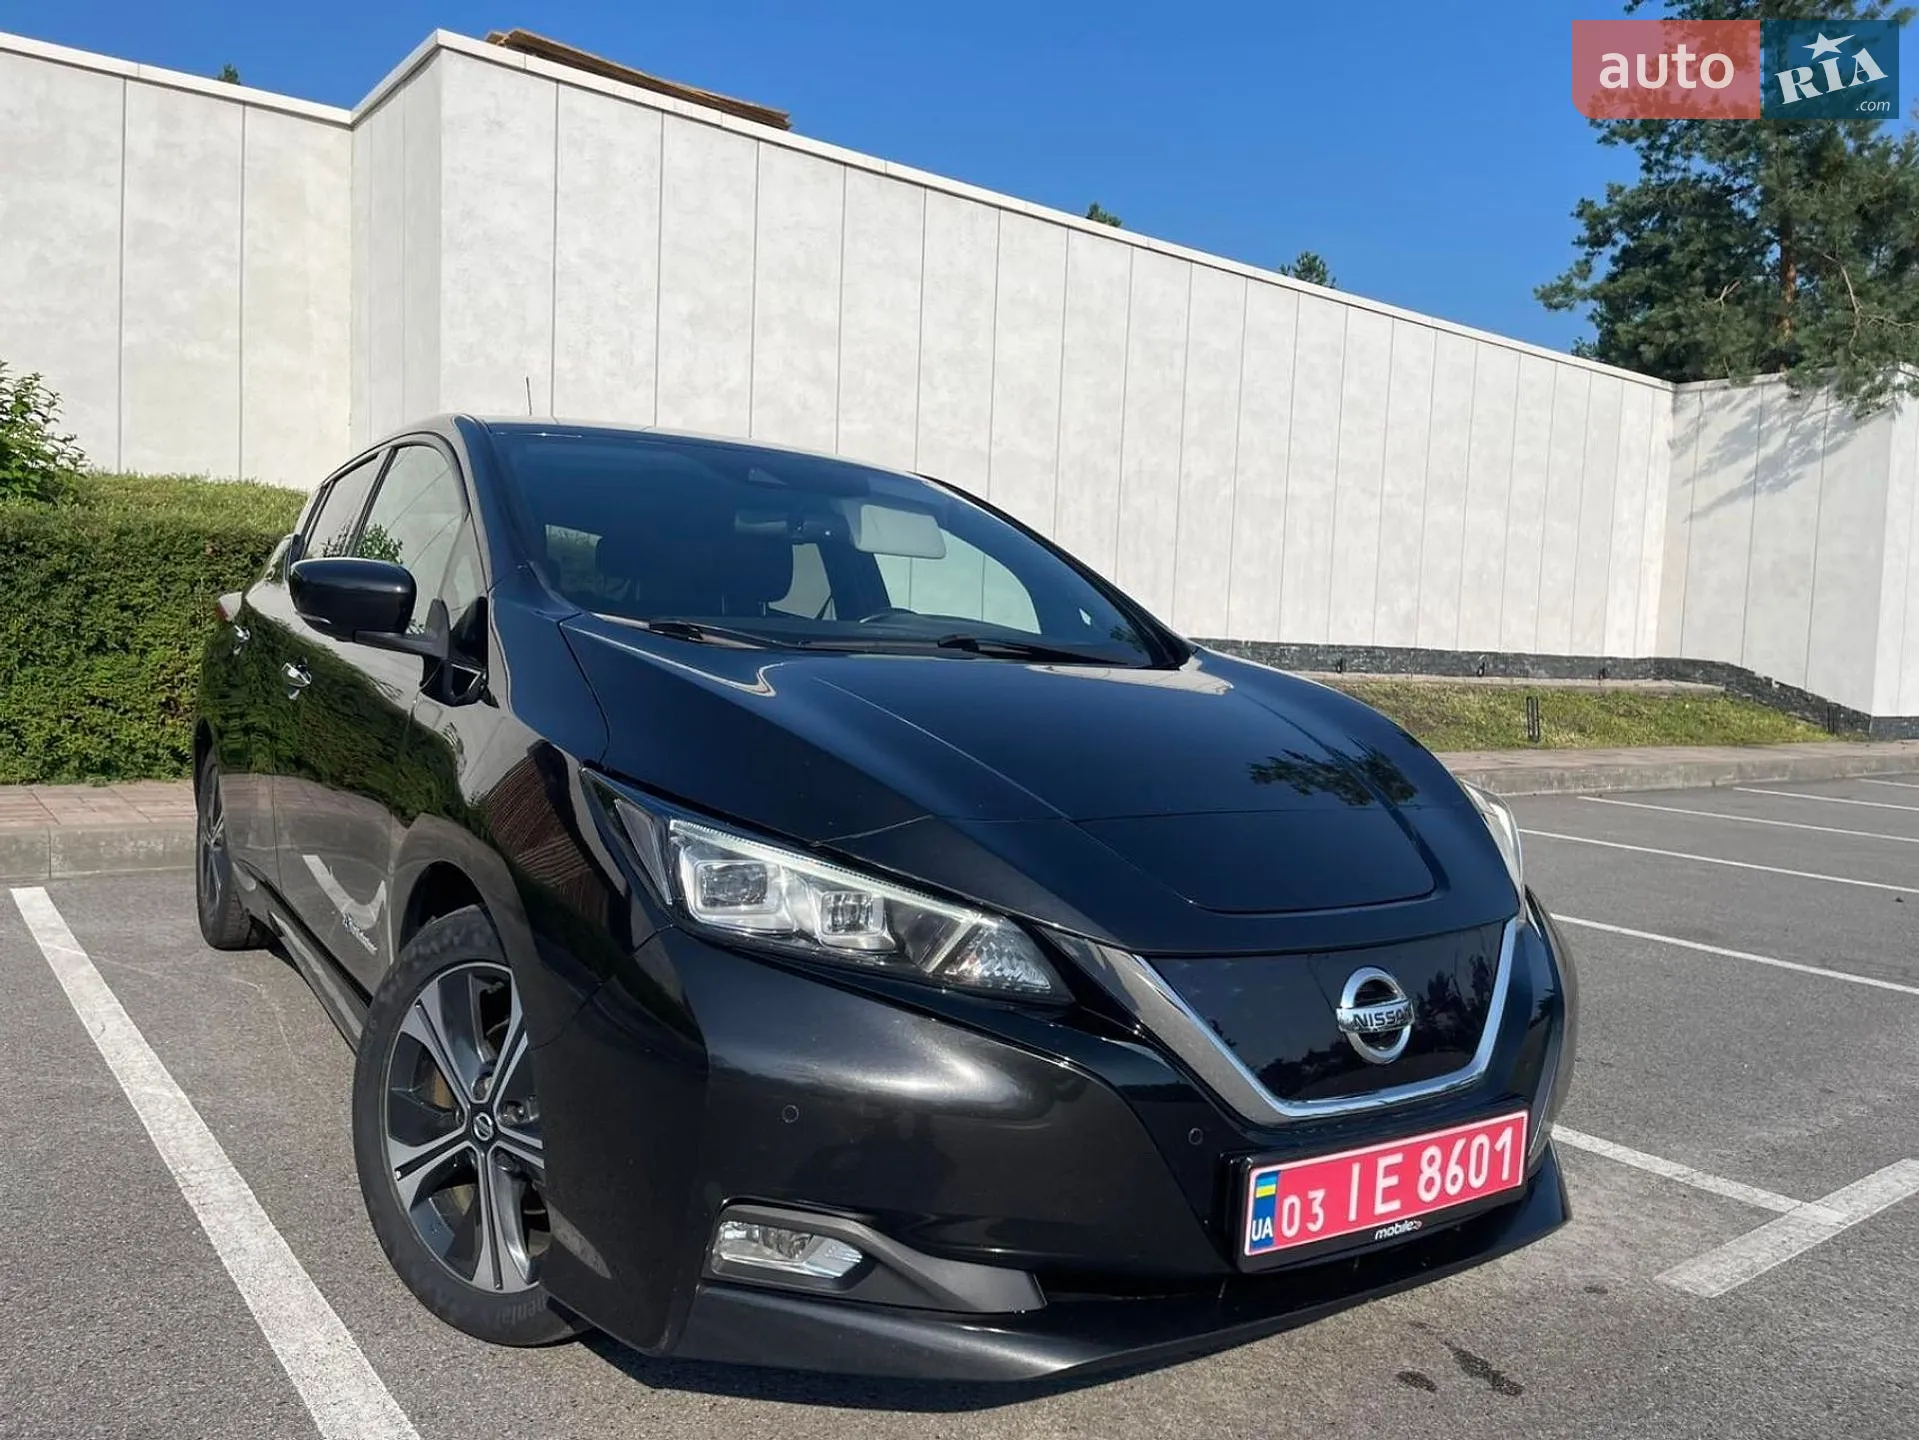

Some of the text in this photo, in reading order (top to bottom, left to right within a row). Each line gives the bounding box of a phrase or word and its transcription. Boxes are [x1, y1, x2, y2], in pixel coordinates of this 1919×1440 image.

[1281, 1126, 1513, 1238] 03 IE 8601
[1250, 1216, 1274, 1242] UA
